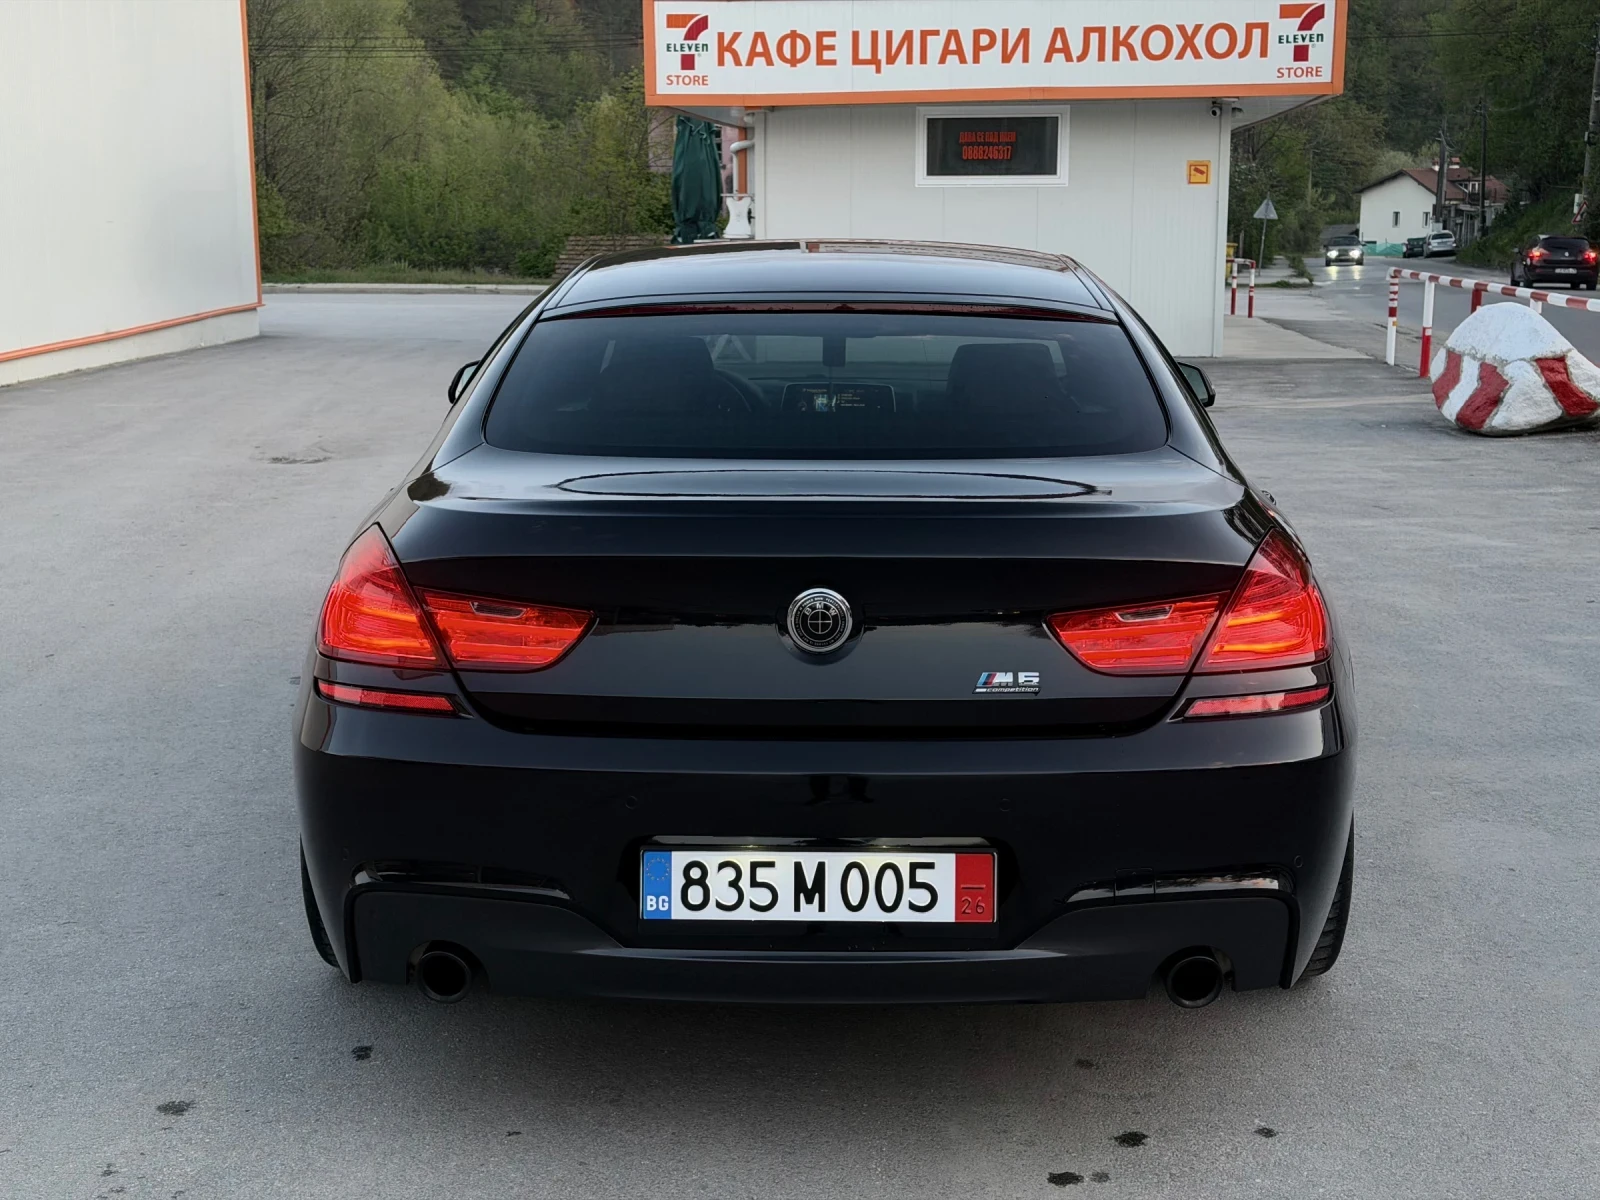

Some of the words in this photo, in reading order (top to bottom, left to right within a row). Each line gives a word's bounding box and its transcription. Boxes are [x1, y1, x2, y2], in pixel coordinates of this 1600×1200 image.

[666, 14, 708, 70] 7
[717, 30, 837, 67] КАФЕ
[851, 28, 1031, 74] ЦИГАРИ
[1044, 22, 1270, 63] АЛКОХОЛ
[1279, 3, 1325, 62] 7
[666, 75, 708, 86] STORE
[1276, 66, 1323, 78] STORE
[646, 895, 669, 911] BG
[680, 860, 779, 912] 835
[793, 861, 826, 913] M
[840, 861, 939, 913] 005
[961, 896, 986, 915] 26
